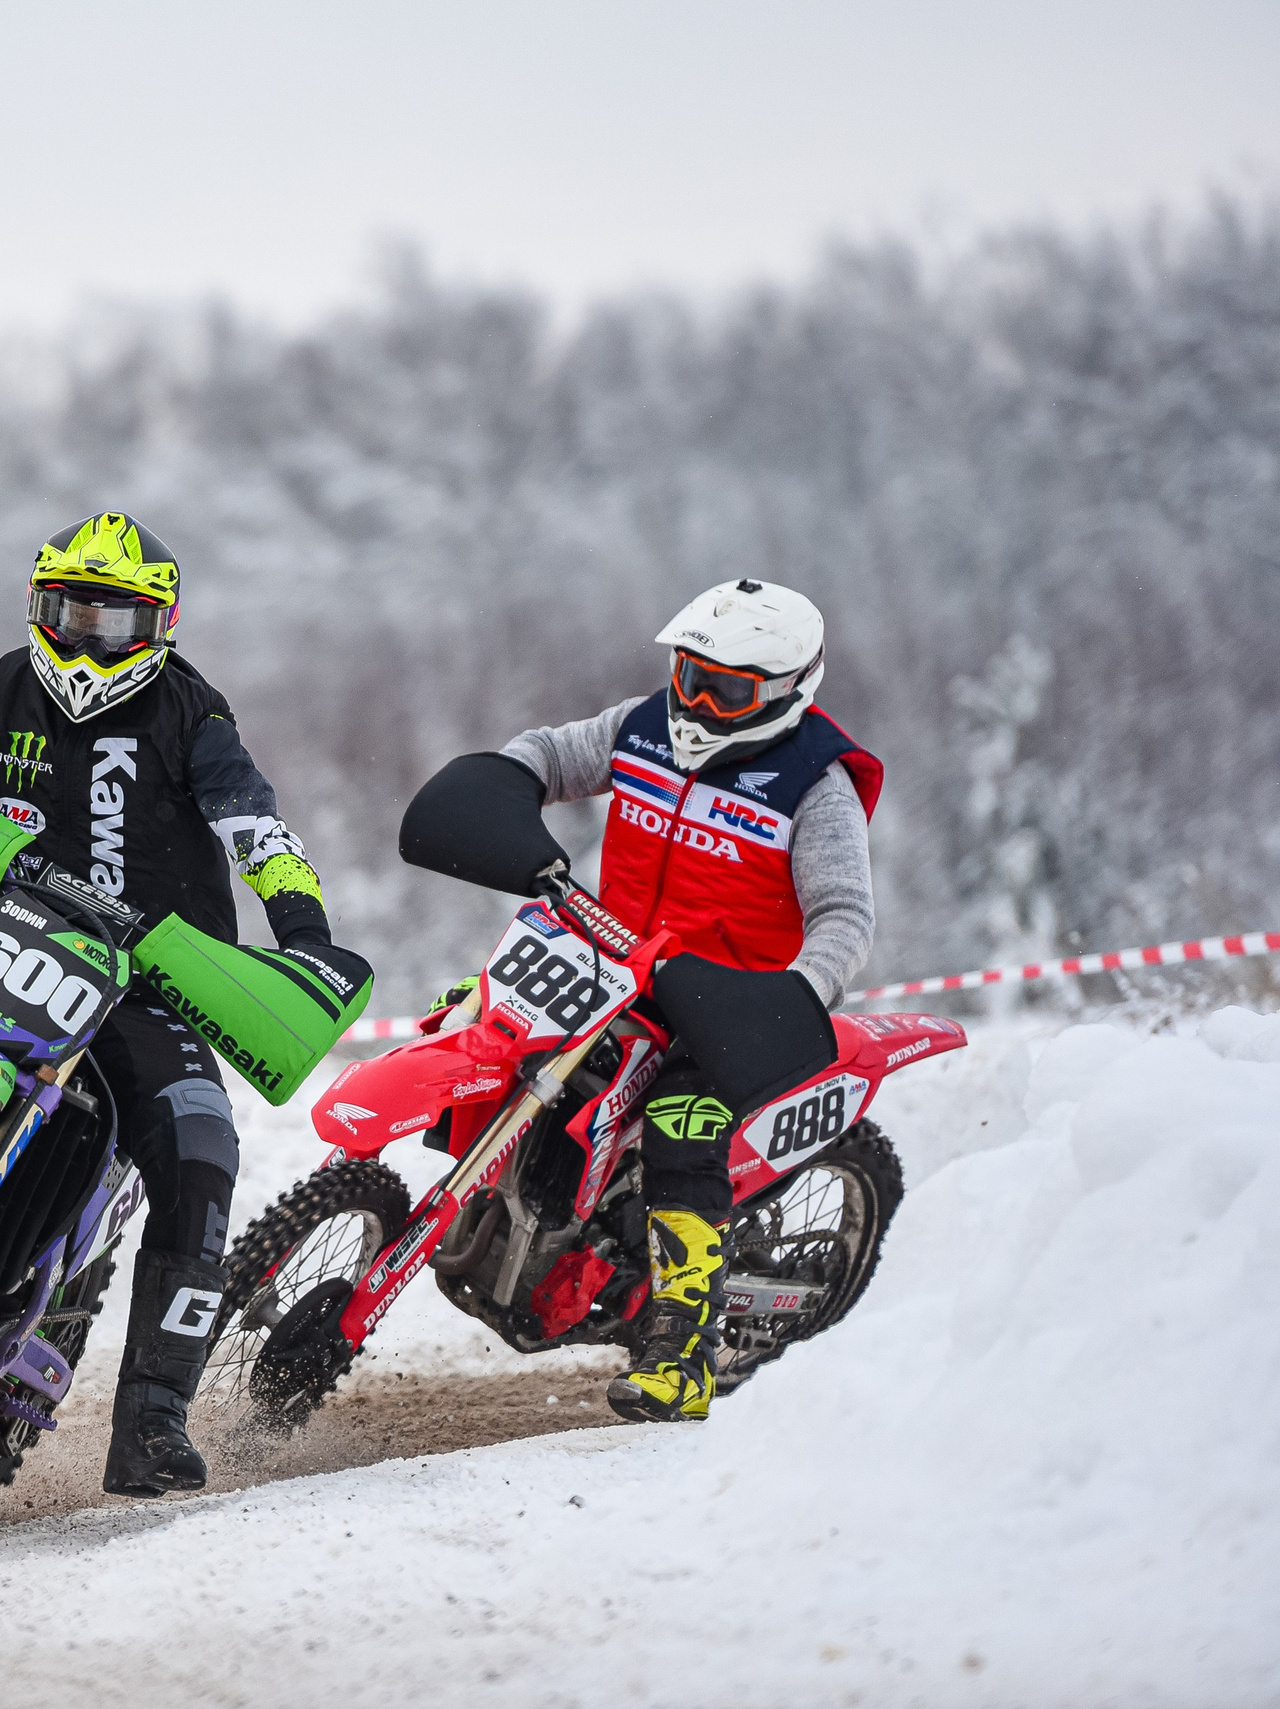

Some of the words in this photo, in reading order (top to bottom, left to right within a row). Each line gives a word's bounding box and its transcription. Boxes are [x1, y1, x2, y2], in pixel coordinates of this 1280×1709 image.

[734, 782, 768, 800] HONDA
[0, 803, 38, 825] AMA
[620, 799, 744, 864] HONDA
[708, 796, 780, 841] HRC
[56, 873, 131, 914] ACERBIS
[0, 900, 48, 930] Зорин
[573, 894, 639, 945] RENTHAL
[284, 948, 354, 992] Kawasaki
[319, 969, 346, 996] Racing
[488, 934, 611, 1033] 888
[146, 963, 284, 1092] Kawasaki
[496, 1003, 531, 1030] HONDA
[518, 1003, 539, 1022] RMG
[886, 1037, 931, 1068] DUNLOP
[607, 1055, 659, 1118] HONDA
[325, 1109, 358, 1136] HONDA
[767, 1085, 845, 1161] 888
[363, 1252, 426, 1331] DUNLOP
